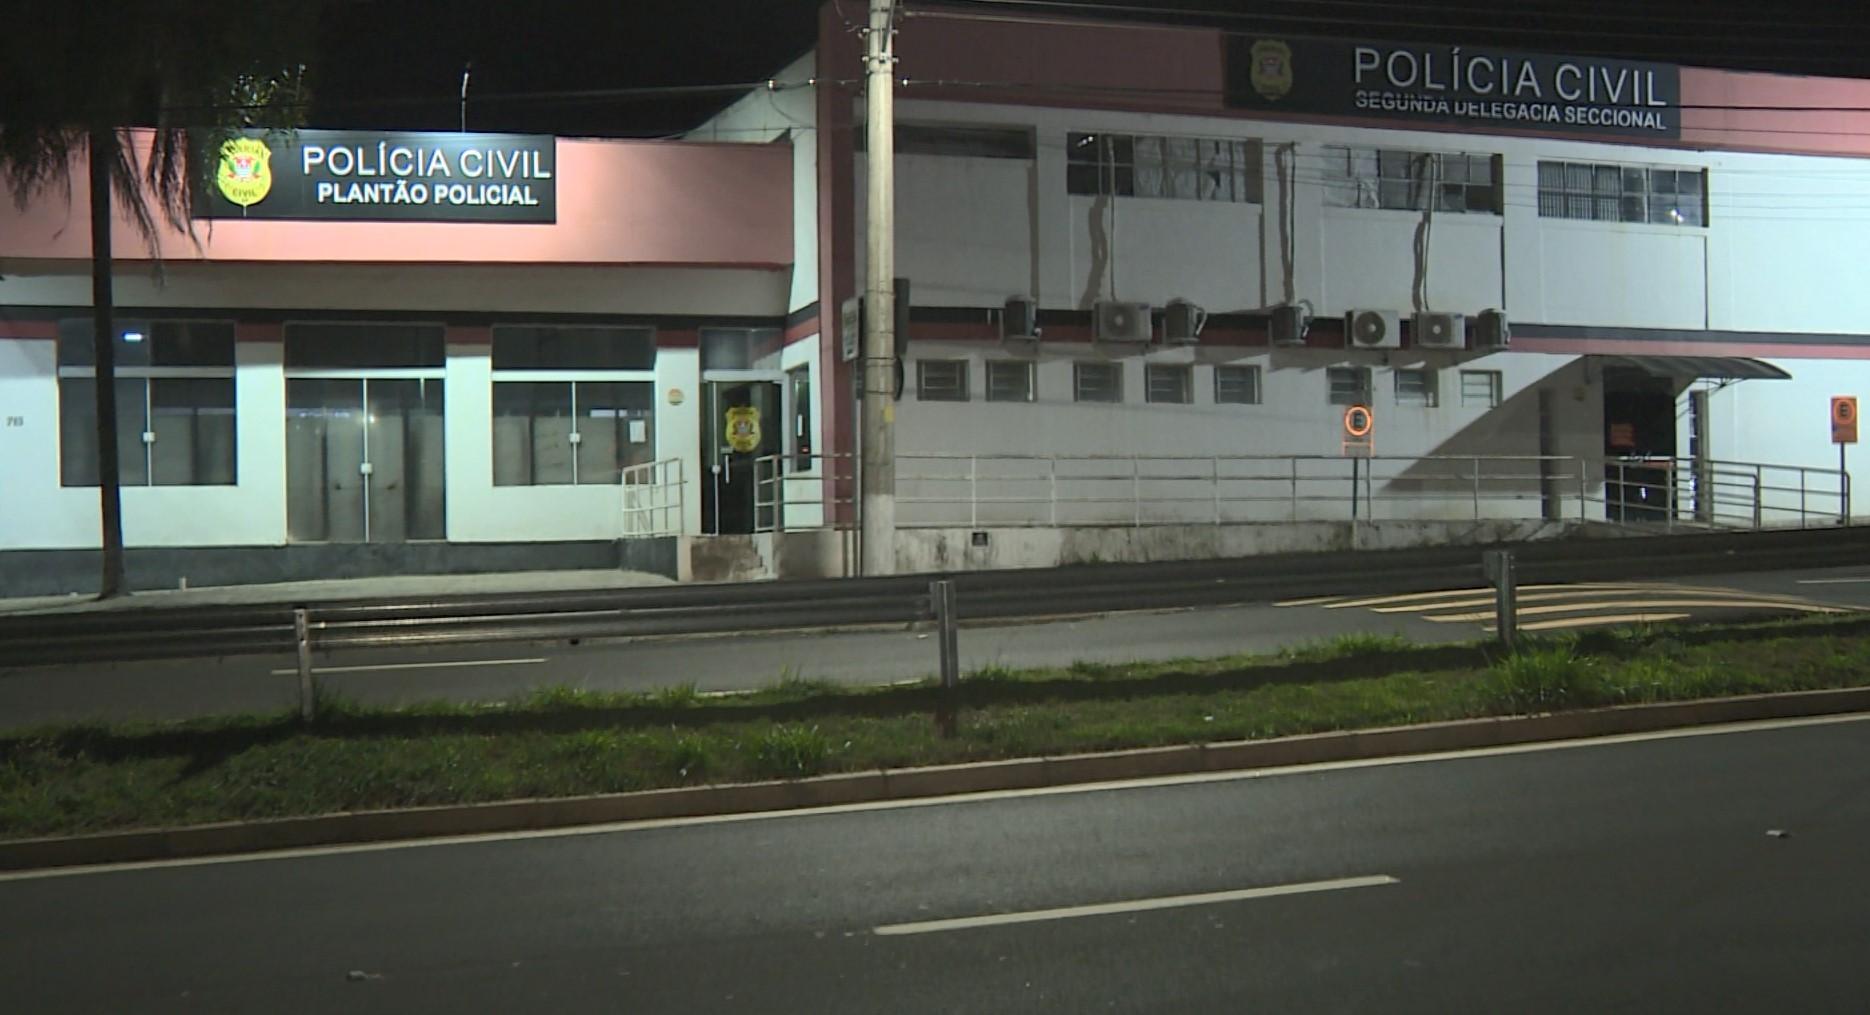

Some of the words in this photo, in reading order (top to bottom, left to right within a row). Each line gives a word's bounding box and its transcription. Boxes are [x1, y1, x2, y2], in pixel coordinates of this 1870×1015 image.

[1354, 47, 1542, 98] POLÍCIA
[1555, 63, 1668, 107] CIVIL
[1355, 90, 1450, 113] SEGUNDA
[1455, 101, 1560, 122] DELEGACIA
[1565, 106, 1668, 130] SECCIONAL
[302, 140, 452, 177] POLÍCIA
[459, 148, 552, 179] CIVIL
[317, 180, 428, 205] PLANTÃO
[434, 184, 539, 206] POLICIAL
